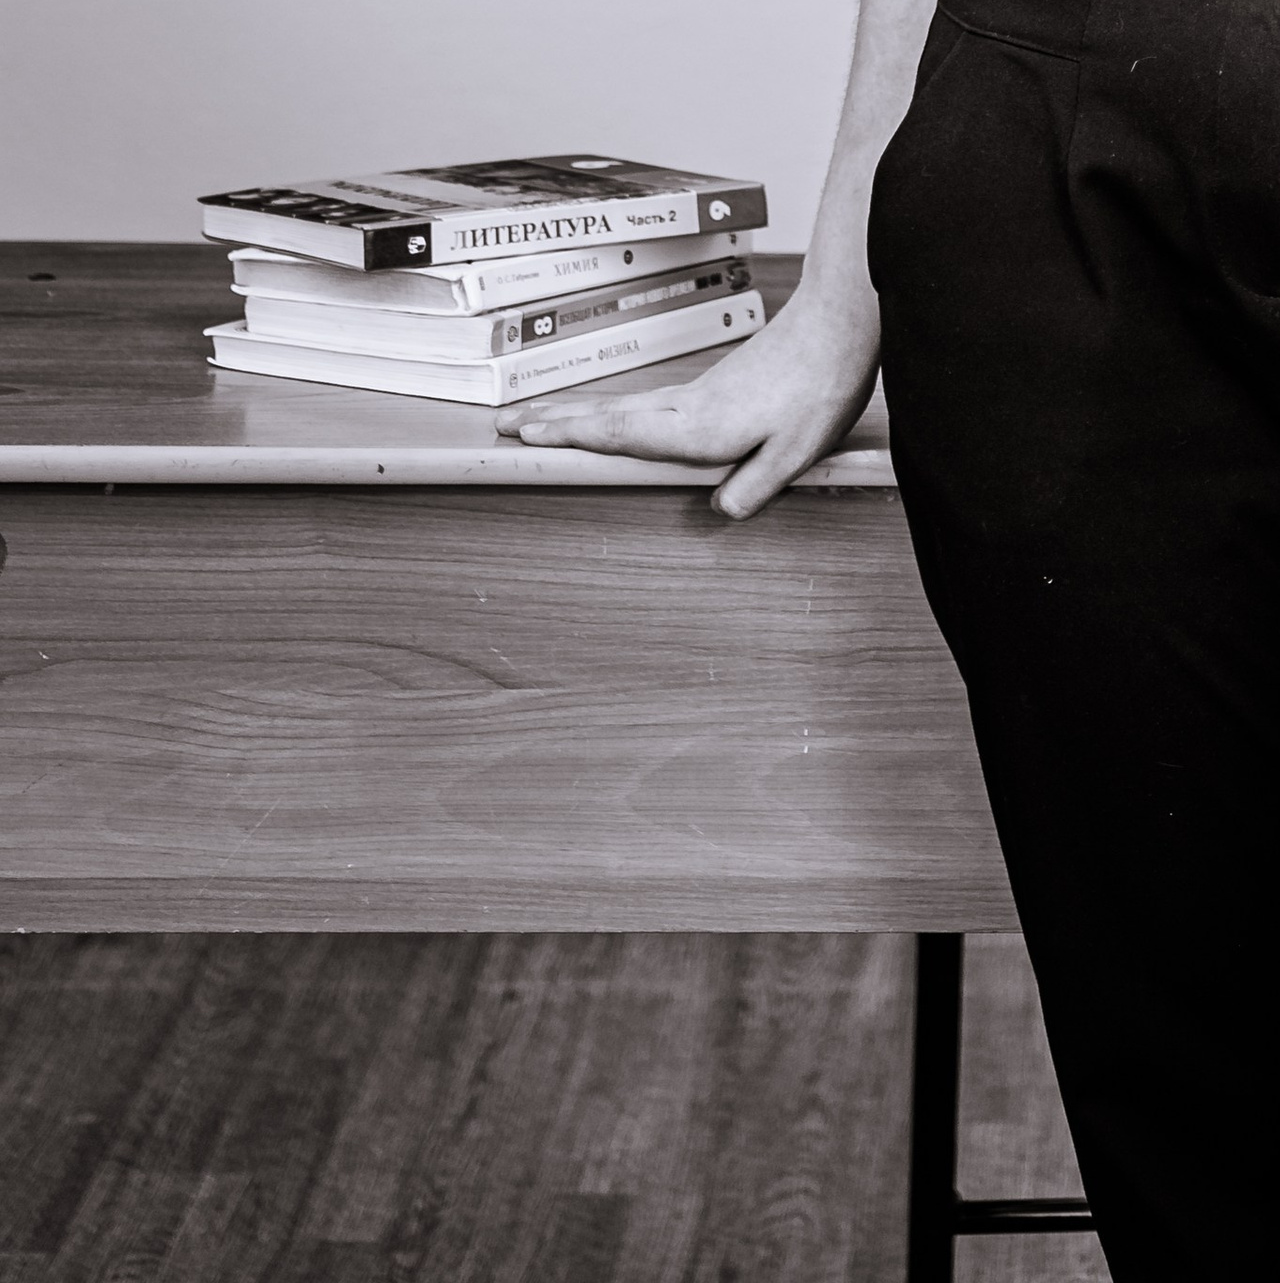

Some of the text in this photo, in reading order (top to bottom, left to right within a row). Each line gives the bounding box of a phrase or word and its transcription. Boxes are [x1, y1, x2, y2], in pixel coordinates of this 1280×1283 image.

[450, 214, 613, 251] ЛИТЕРАТУРА
[626, 214, 666, 227] Часть
[668, 210, 677, 222] 2
[554, 257, 599, 277] ХИМИЯ
[598, 339, 640, 361] ФИЗИКА
